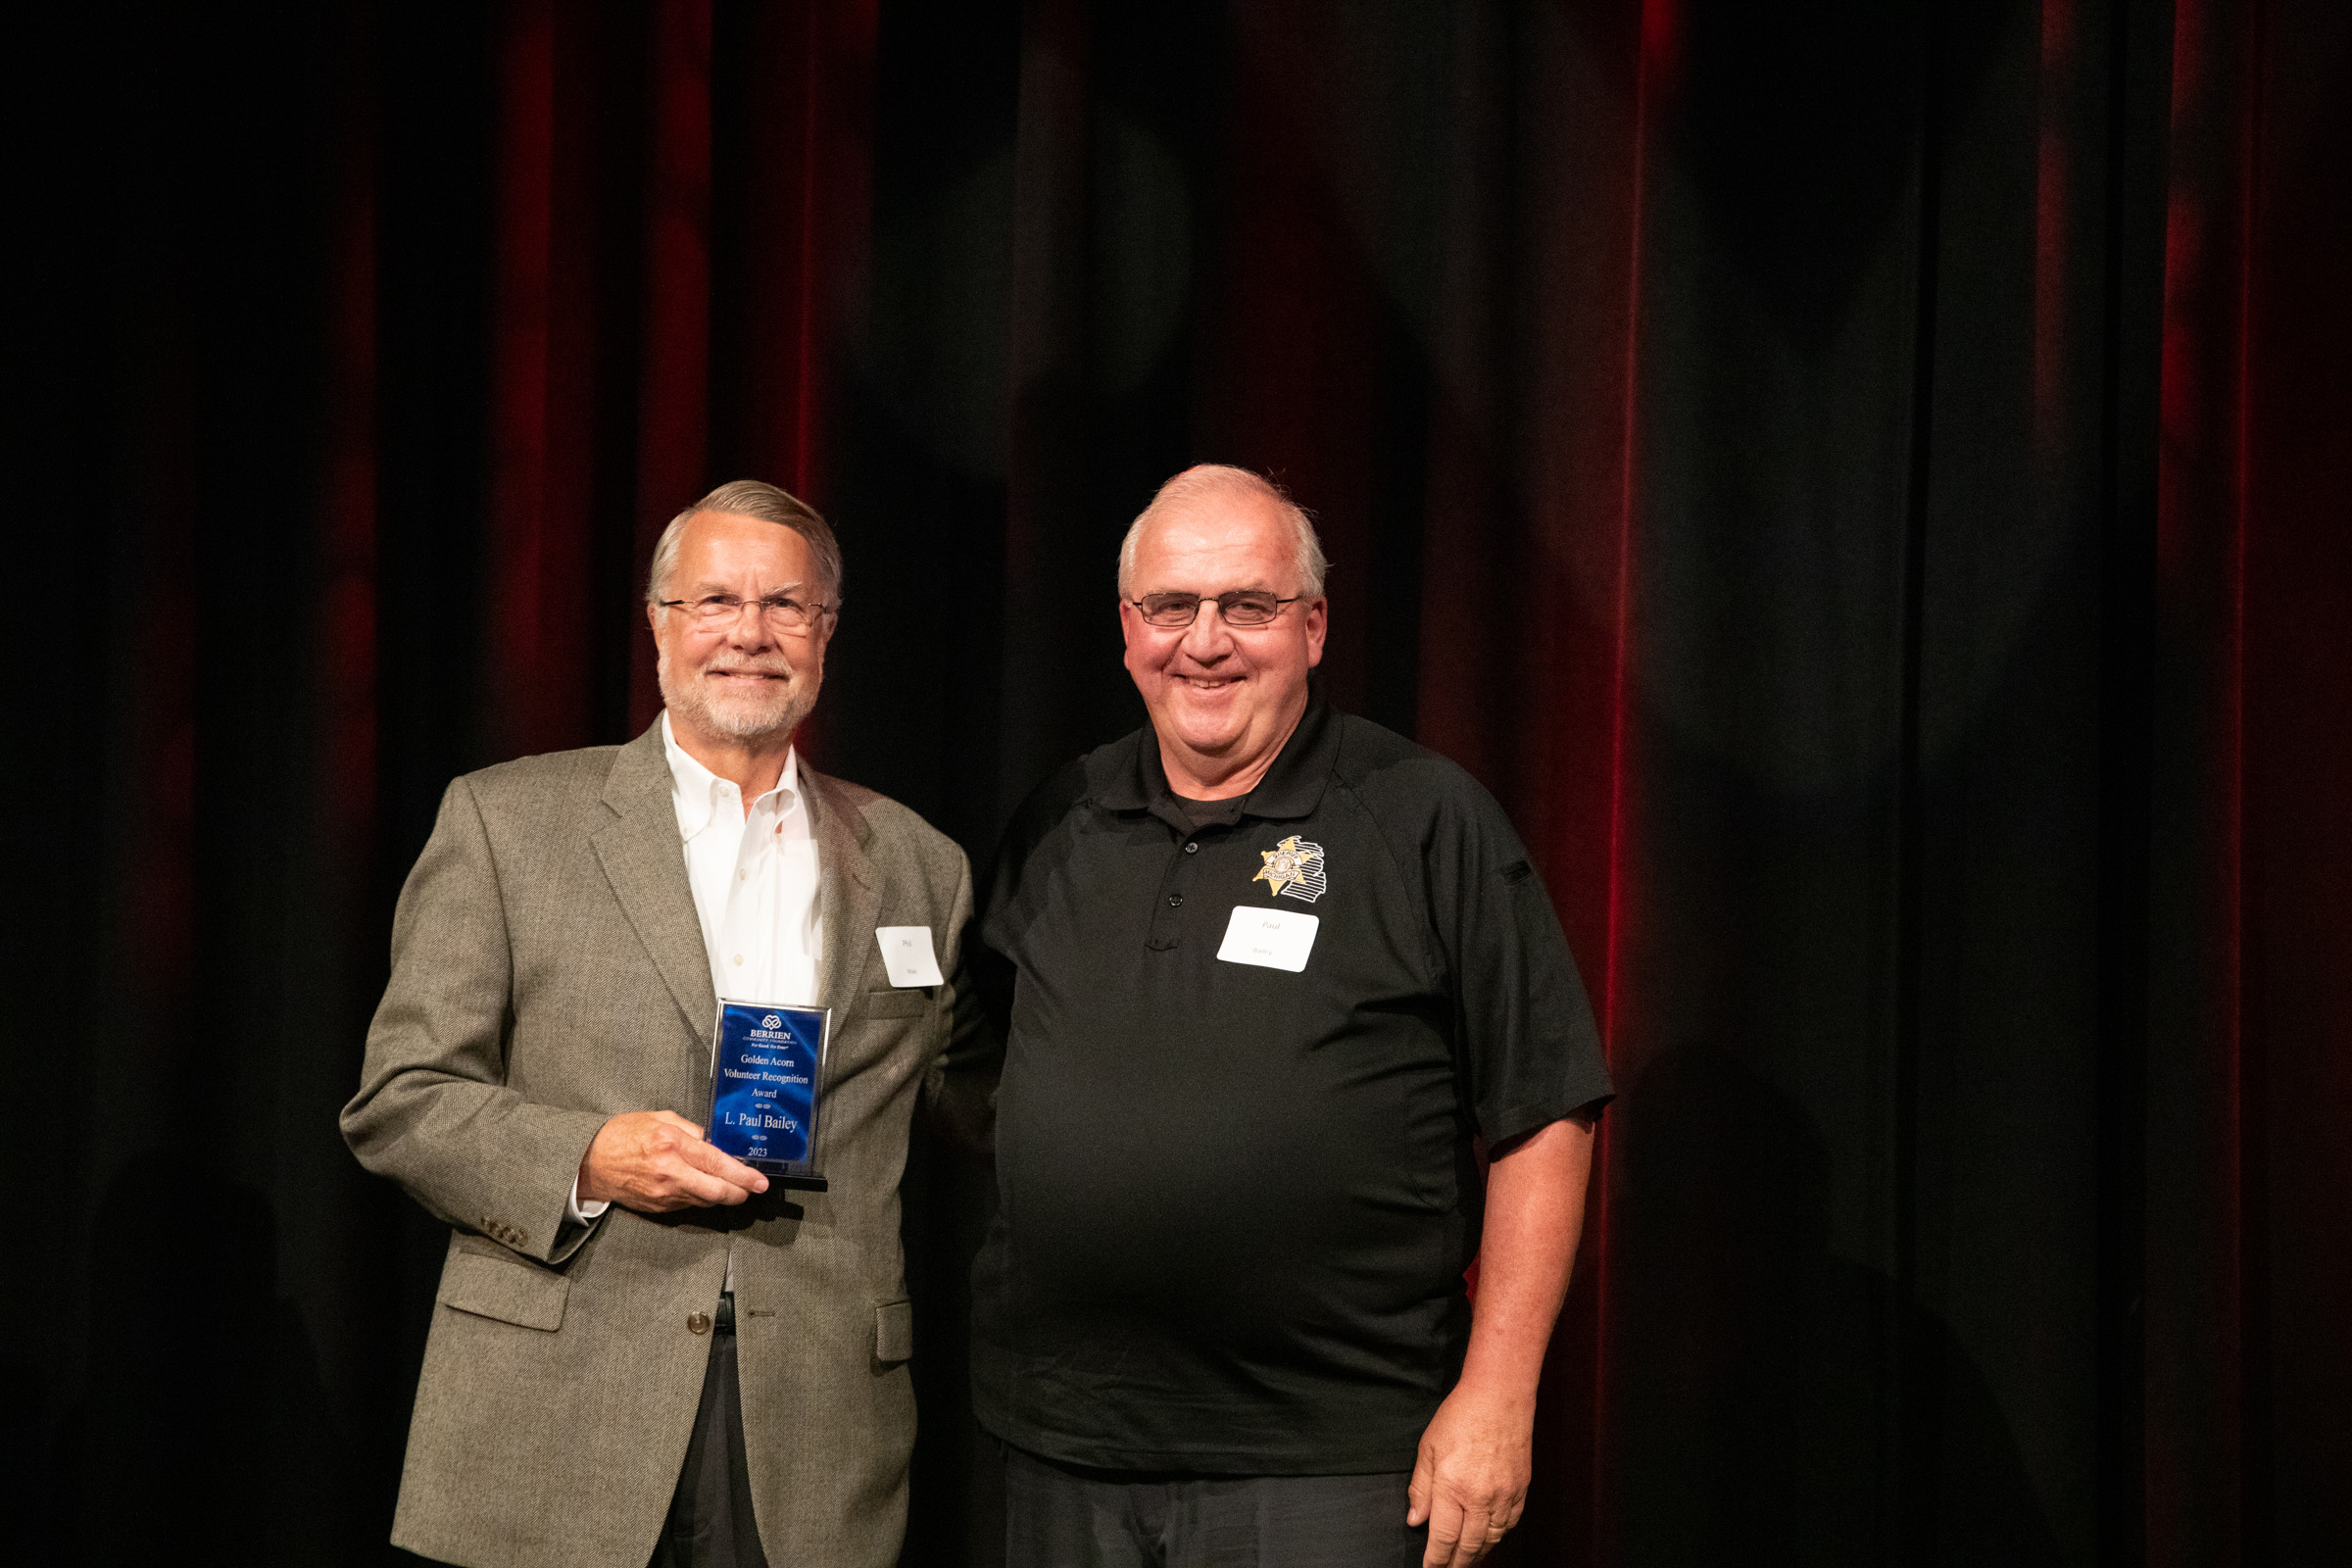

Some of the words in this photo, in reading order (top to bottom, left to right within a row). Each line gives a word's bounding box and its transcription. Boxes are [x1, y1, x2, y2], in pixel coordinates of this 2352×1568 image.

[1265, 869, 1295, 879] MICHIGAN
[1261, 920, 1281, 930] Paul
[750, 1030, 791, 1040] BERRIEN
[741, 1054, 769, 1065] Golden
[770, 1058, 794, 1067] Acorn
[724, 1068, 761, 1080] Volunteer
[762, 1073, 808, 1084] Recognition
[752, 1088, 777, 1099] Award
[724, 1112, 735, 1125] L.
[739, 1113, 761, 1127] Paul
[764, 1115, 798, 1133] Bailey
[748, 1147, 767, 1157] 2023
